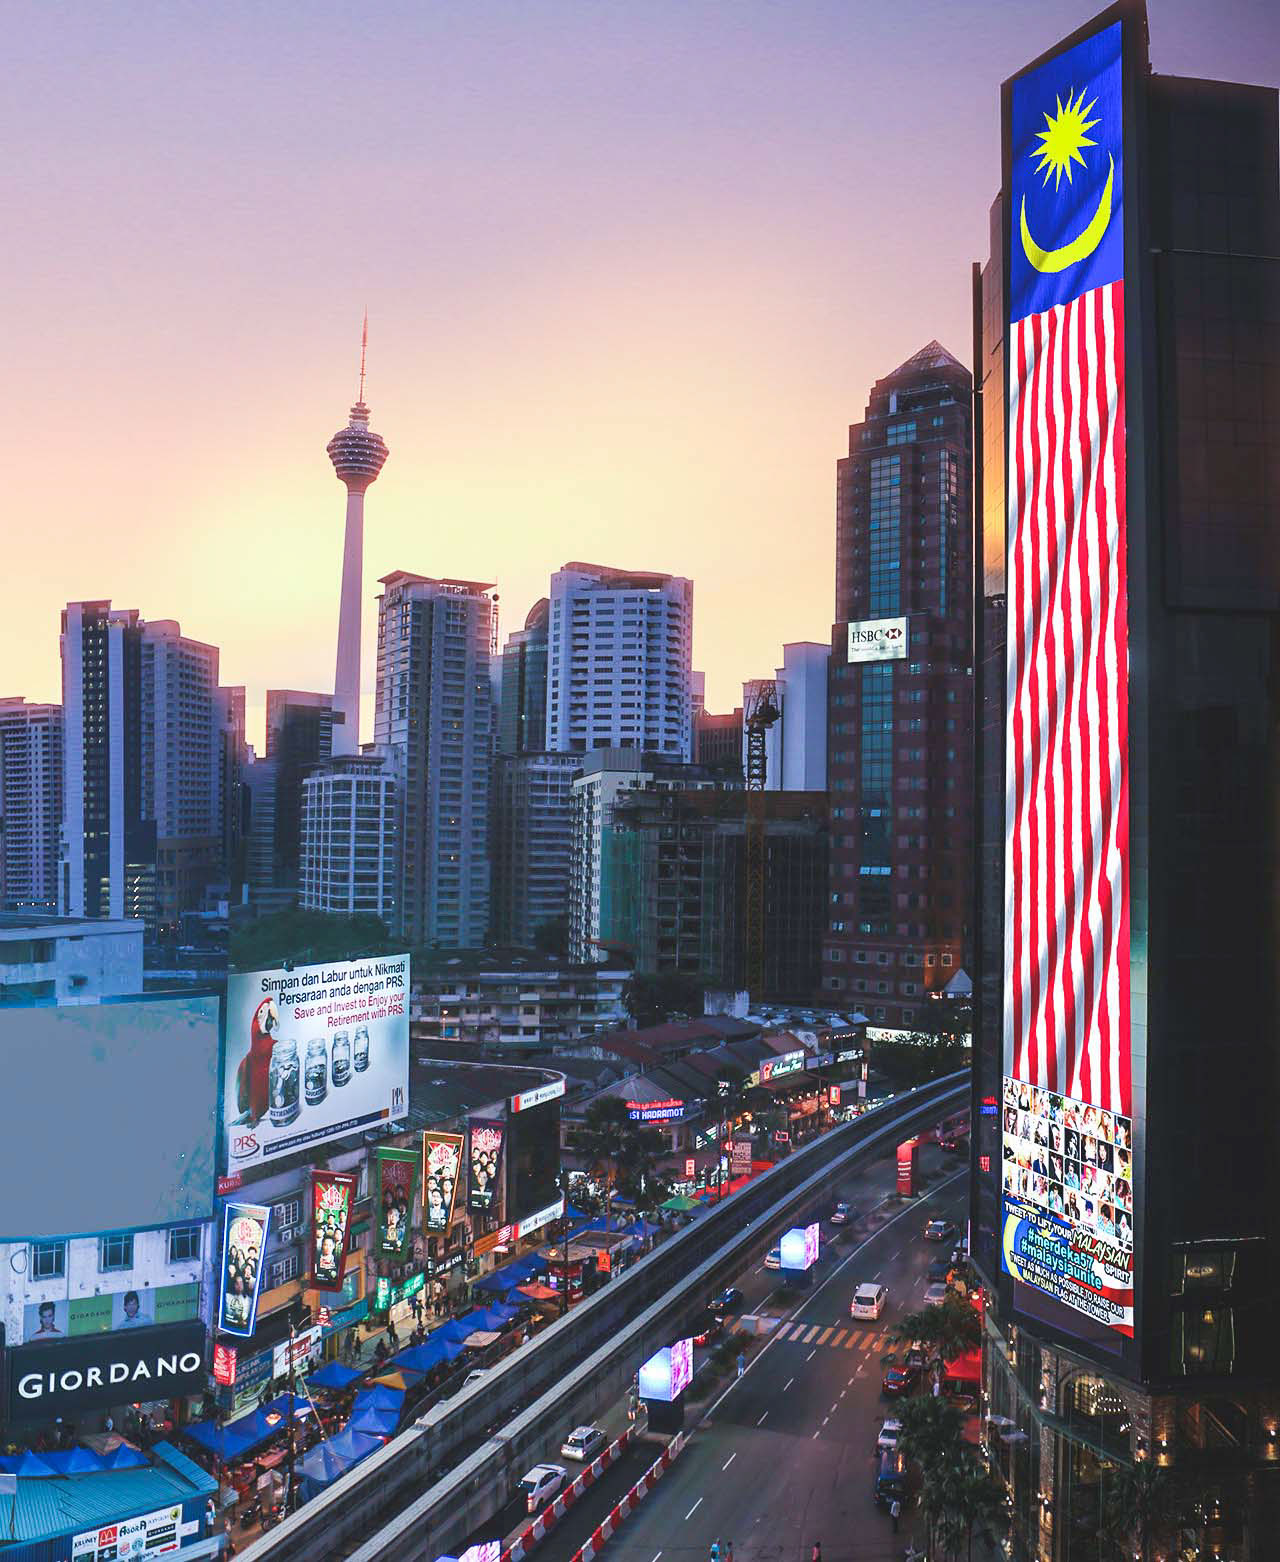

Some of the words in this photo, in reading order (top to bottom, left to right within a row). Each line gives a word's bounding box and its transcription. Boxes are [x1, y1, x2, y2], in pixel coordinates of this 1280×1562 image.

[852, 629, 883, 643] HSBC
[261, 976, 299, 993] Simpan
[302, 972, 319, 987] dan
[321, 969, 347, 984] Labur
[349, 965, 373, 980] untuk
[375, 961, 406, 976] Nikmati
[279, 989, 327, 1006] Persaraan
[330, 984, 351, 998] anda
[353, 979, 384, 995] dengan
[386, 975, 405, 989] PRS.
[294, 1007, 315, 1020] Save
[317, 1003, 332, 1017] and
[334, 998, 357, 1013] Invest
[359, 998, 367, 1010] to
[368, 995, 388, 1009] Enjoy
[390, 992, 405, 1006] your
[327, 1010, 370, 1028] Retirement
[371, 1006, 387, 1020] with
[388, 1003, 405, 1017] PRS.
[233, 1133, 257, 1153] PRS
[1005, 1201, 1026, 1220] TWEET
[1026, 1213, 1037, 1224] TO
[1038, 1216, 1052, 1231] LIFT
[1052, 1223, 1072, 1241] YOUR
[1072, 1229, 1130, 1269] MALAYSIAN
[1027, 1226, 1094, 1269] #merdeka57
[1021, 1238, 1103, 1290] #malaysiaunite
[1104, 1262, 1130, 1283] SPIRIT
[1022, 1268, 1053, 1293] MALAYSIAN
[1053, 1284, 1069, 1304] FLAG
[1069, 1292, 1077, 1306] AT
[1076, 1295, 1087, 1312] THE
[1027, 1259, 1035, 1271] AS
[1035, 1262, 1050, 1280] MUCH
[1050, 1272, 1058, 1284] AS
[1058, 1276, 1085, 1298] POSSIBLE
[1084, 1287, 1093, 1301] TO
[1093, 1292, 1110, 1309] RAISE
[1110, 1302, 1124, 1319] OUR
[70, 1309, 111, 1320] GIORDANO
[18, 1352, 201, 1399] GIORDANO
